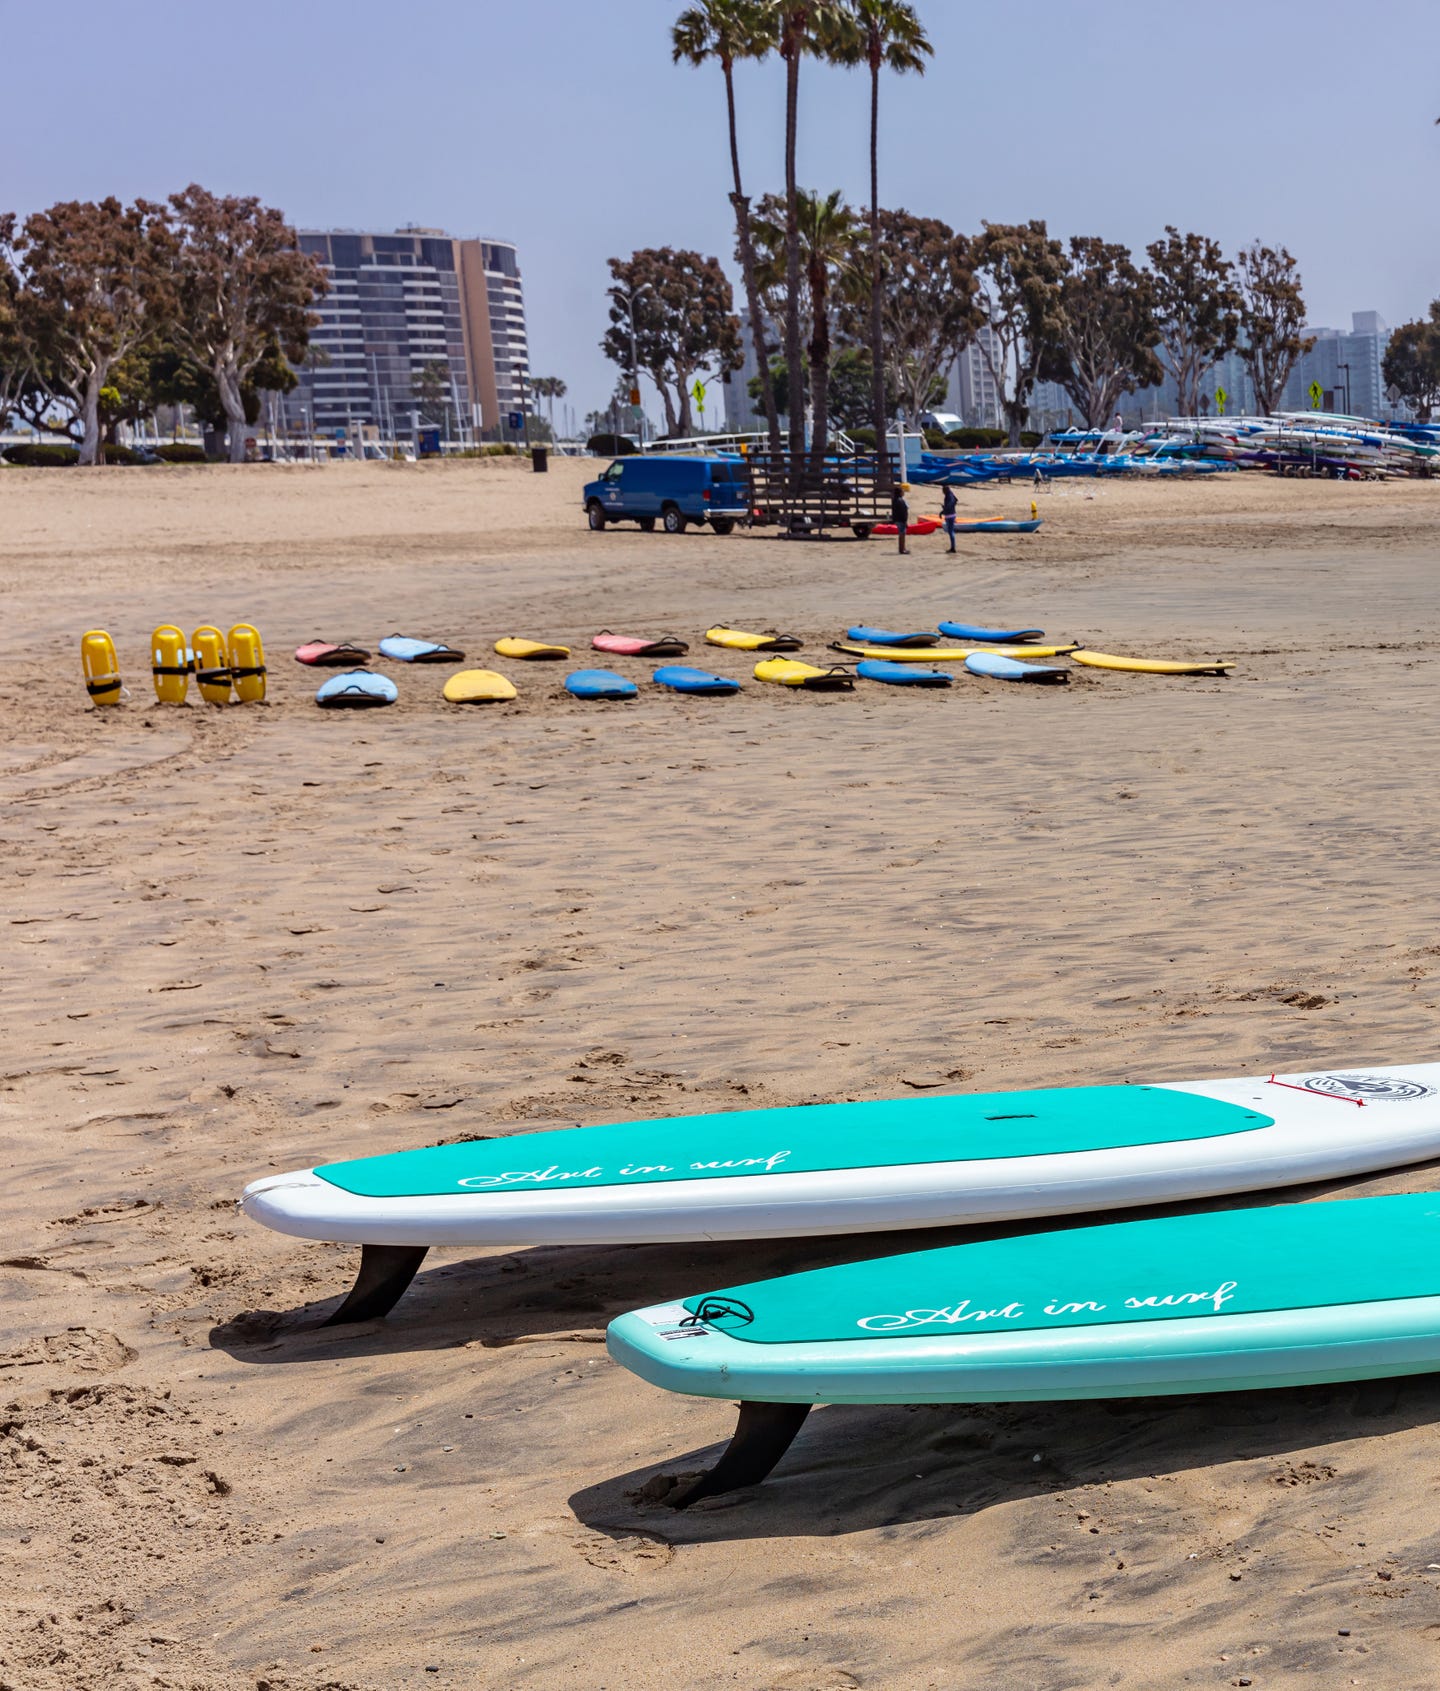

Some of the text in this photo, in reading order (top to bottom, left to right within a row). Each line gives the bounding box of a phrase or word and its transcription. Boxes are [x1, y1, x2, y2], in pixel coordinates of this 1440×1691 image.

[457, 1150, 792, 1187] Art in surf
[856, 1281, 1238, 1331] Art in surf
